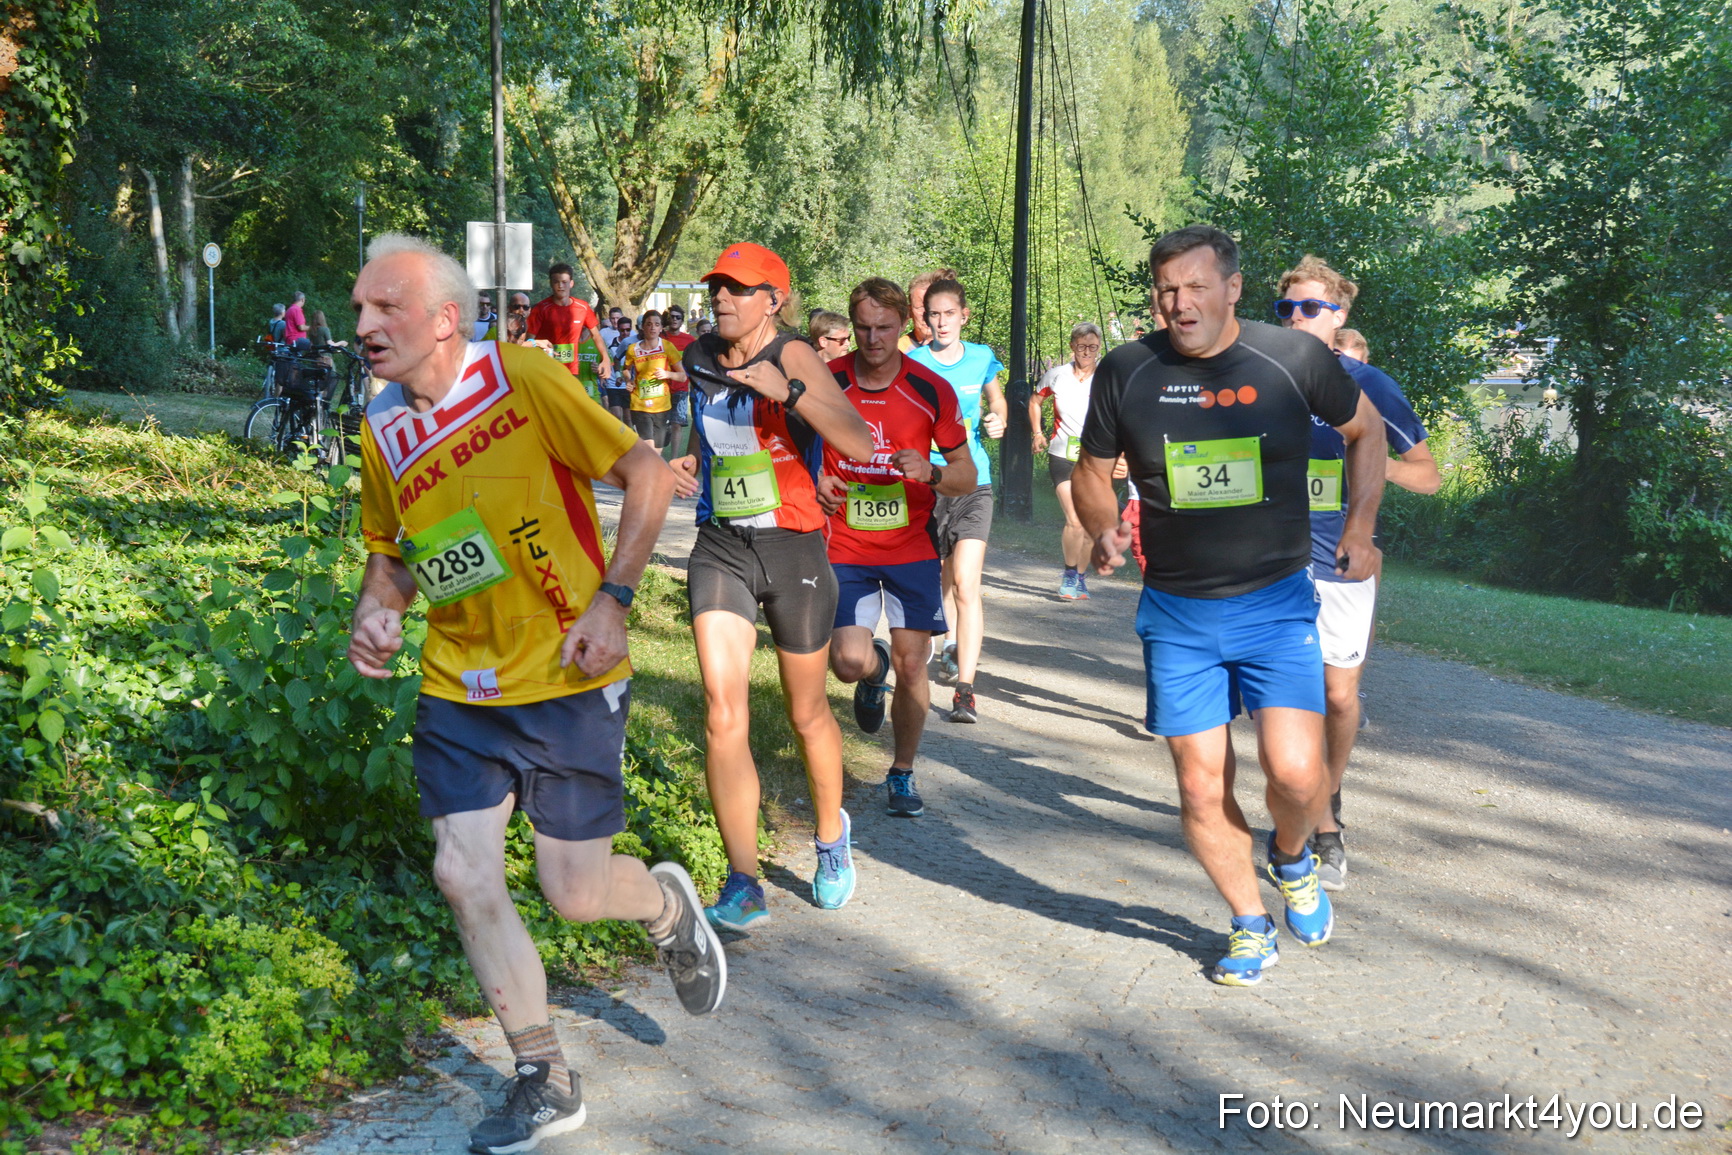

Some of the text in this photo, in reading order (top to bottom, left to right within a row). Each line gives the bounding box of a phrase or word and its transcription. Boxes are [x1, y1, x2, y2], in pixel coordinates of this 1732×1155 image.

[1166, 384, 1200, 393] APTIV
[1159, 395, 1188, 405] Running
[713, 442, 748, 450] AUTOHAUS
[398, 407, 530, 516] MAX BÖGL
[838, 459, 888, 475] Fördertechnik
[1196, 463, 1231, 489] 34
[723, 477, 748, 499] 41
[1187, 488, 1243, 497] Maier Alexander
[747, 497, 765, 505] Ulrike
[853, 499, 899, 517] 1360
[416, 541, 485, 587] 1289
[440, 571, 481, 592] Graf Johann
